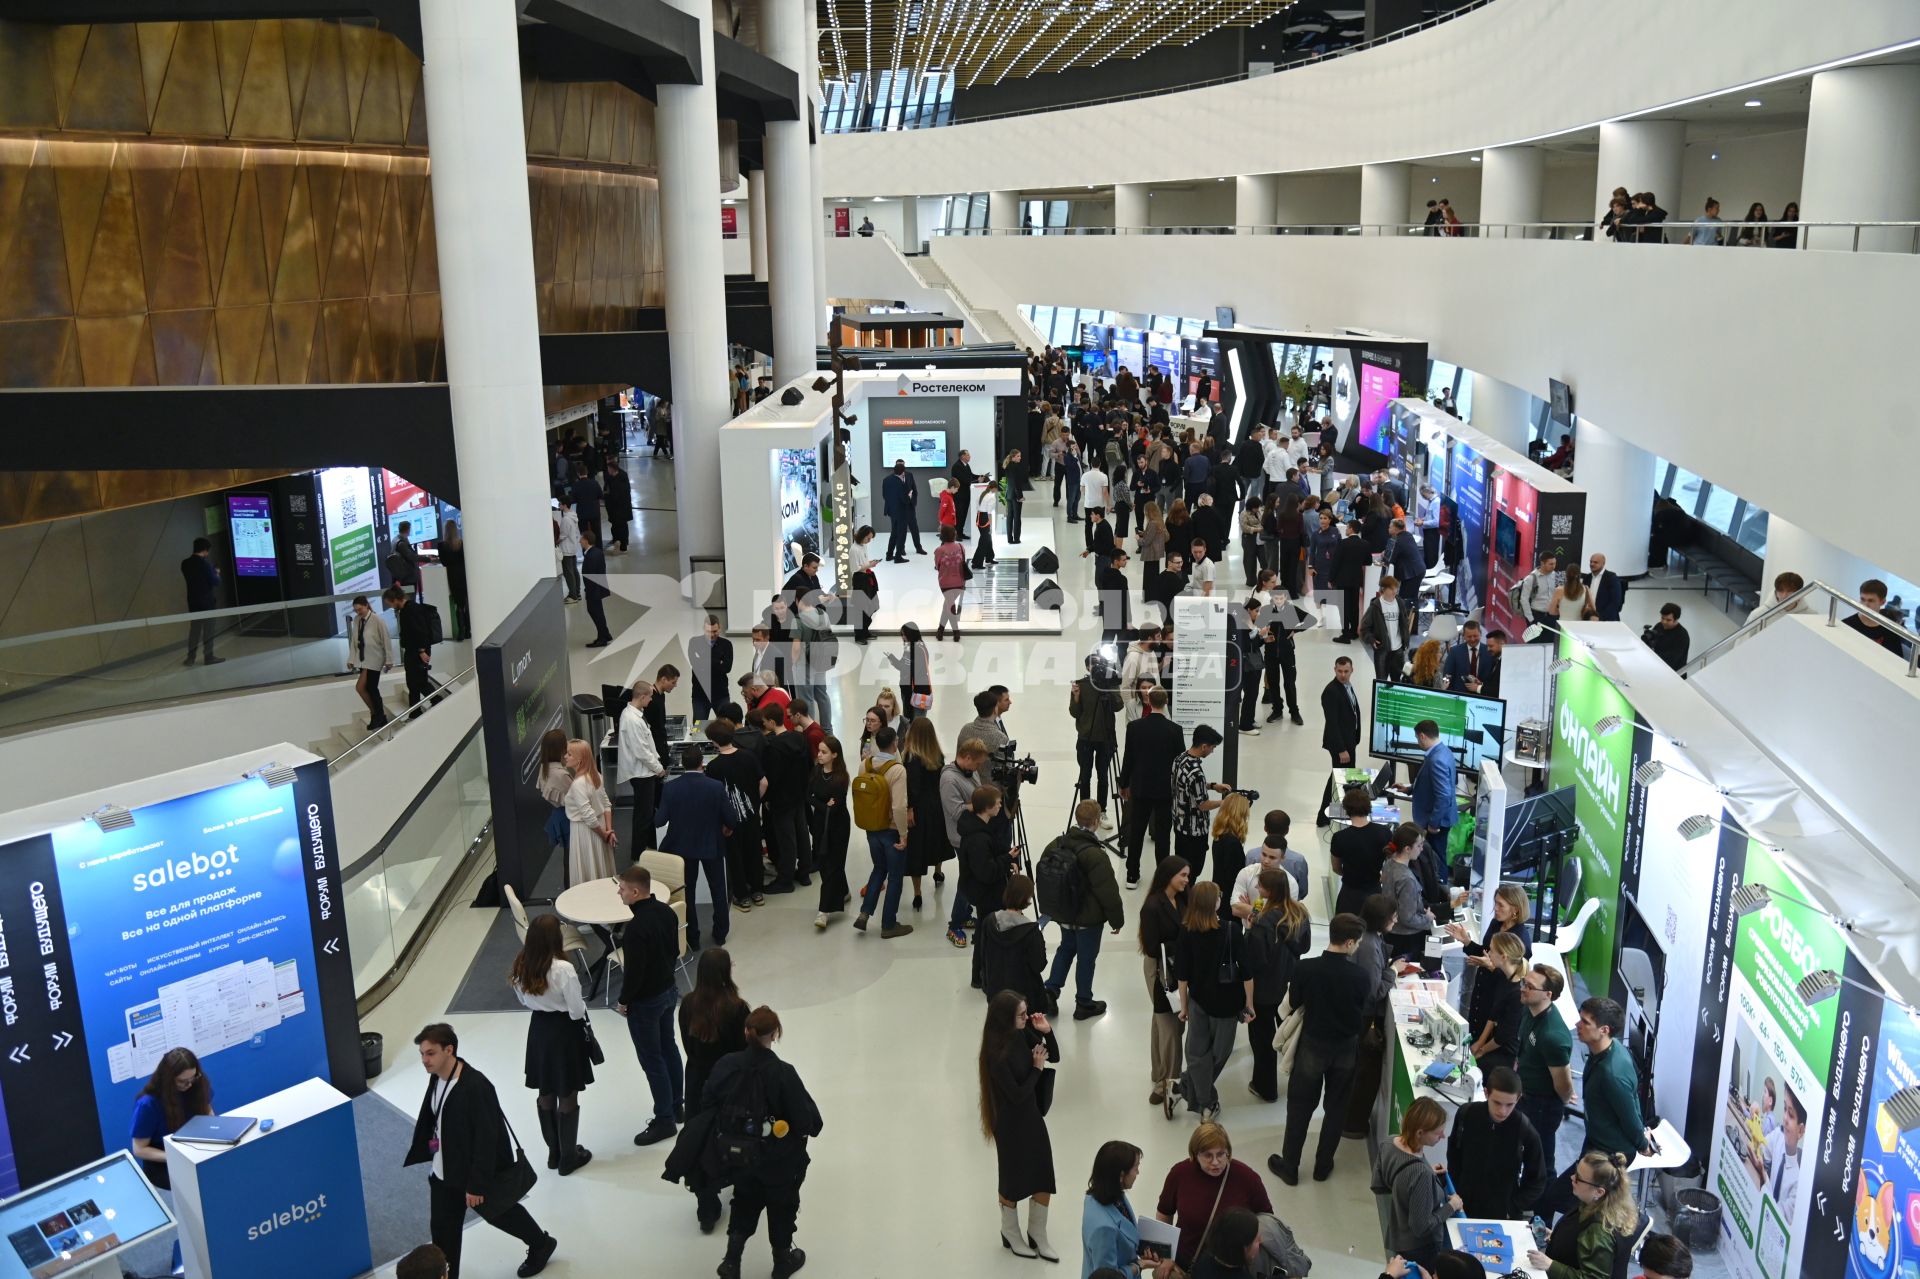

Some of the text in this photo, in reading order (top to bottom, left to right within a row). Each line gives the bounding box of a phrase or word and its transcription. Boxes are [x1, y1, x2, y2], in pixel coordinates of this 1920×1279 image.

[912, 382, 986, 393] Ростелеком
[1560, 699, 1620, 815] ОНЛАЙН
[1624, 753, 1638, 862] ФОРУМ БУДУЩЕГО
[132, 843, 240, 892] salebot
[307, 803, 332, 921] ФОРУМ БУДУЩЕГО
[1633, 835, 1641, 875] ФОРУМ
[122, 890, 262, 941] Все на одной платформе
[145, 886, 237, 920] Все для продаж
[1706, 857, 1725, 984] ФОРУМ БУДУЩЕГО
[29, 881, 62, 1011] ФОРУМ БУДУЩЕГО
[104, 915, 287, 977] ЧАТ-БОТЫ ИСКУССТВЕННЫЙ ИНТЕЛЛЕКТ ОНЛАЙН-ЗАПИСЬ
[109, 974, 133, 987] САЙТЫ
[139, 952, 201, 977] ОНЛАЙН-МАГАЗИНЫ
[208, 942, 230, 954] КУРСЫ
[1718, 955, 1729, 1003] ФОРУМ
[1824, 1011, 1850, 1164] ФОРУМ БУДУЩЕГО
[1842, 1035, 1870, 1194] ФОРУМ БУДУЩЕГО
[248, 1192, 328, 1241] salebot
